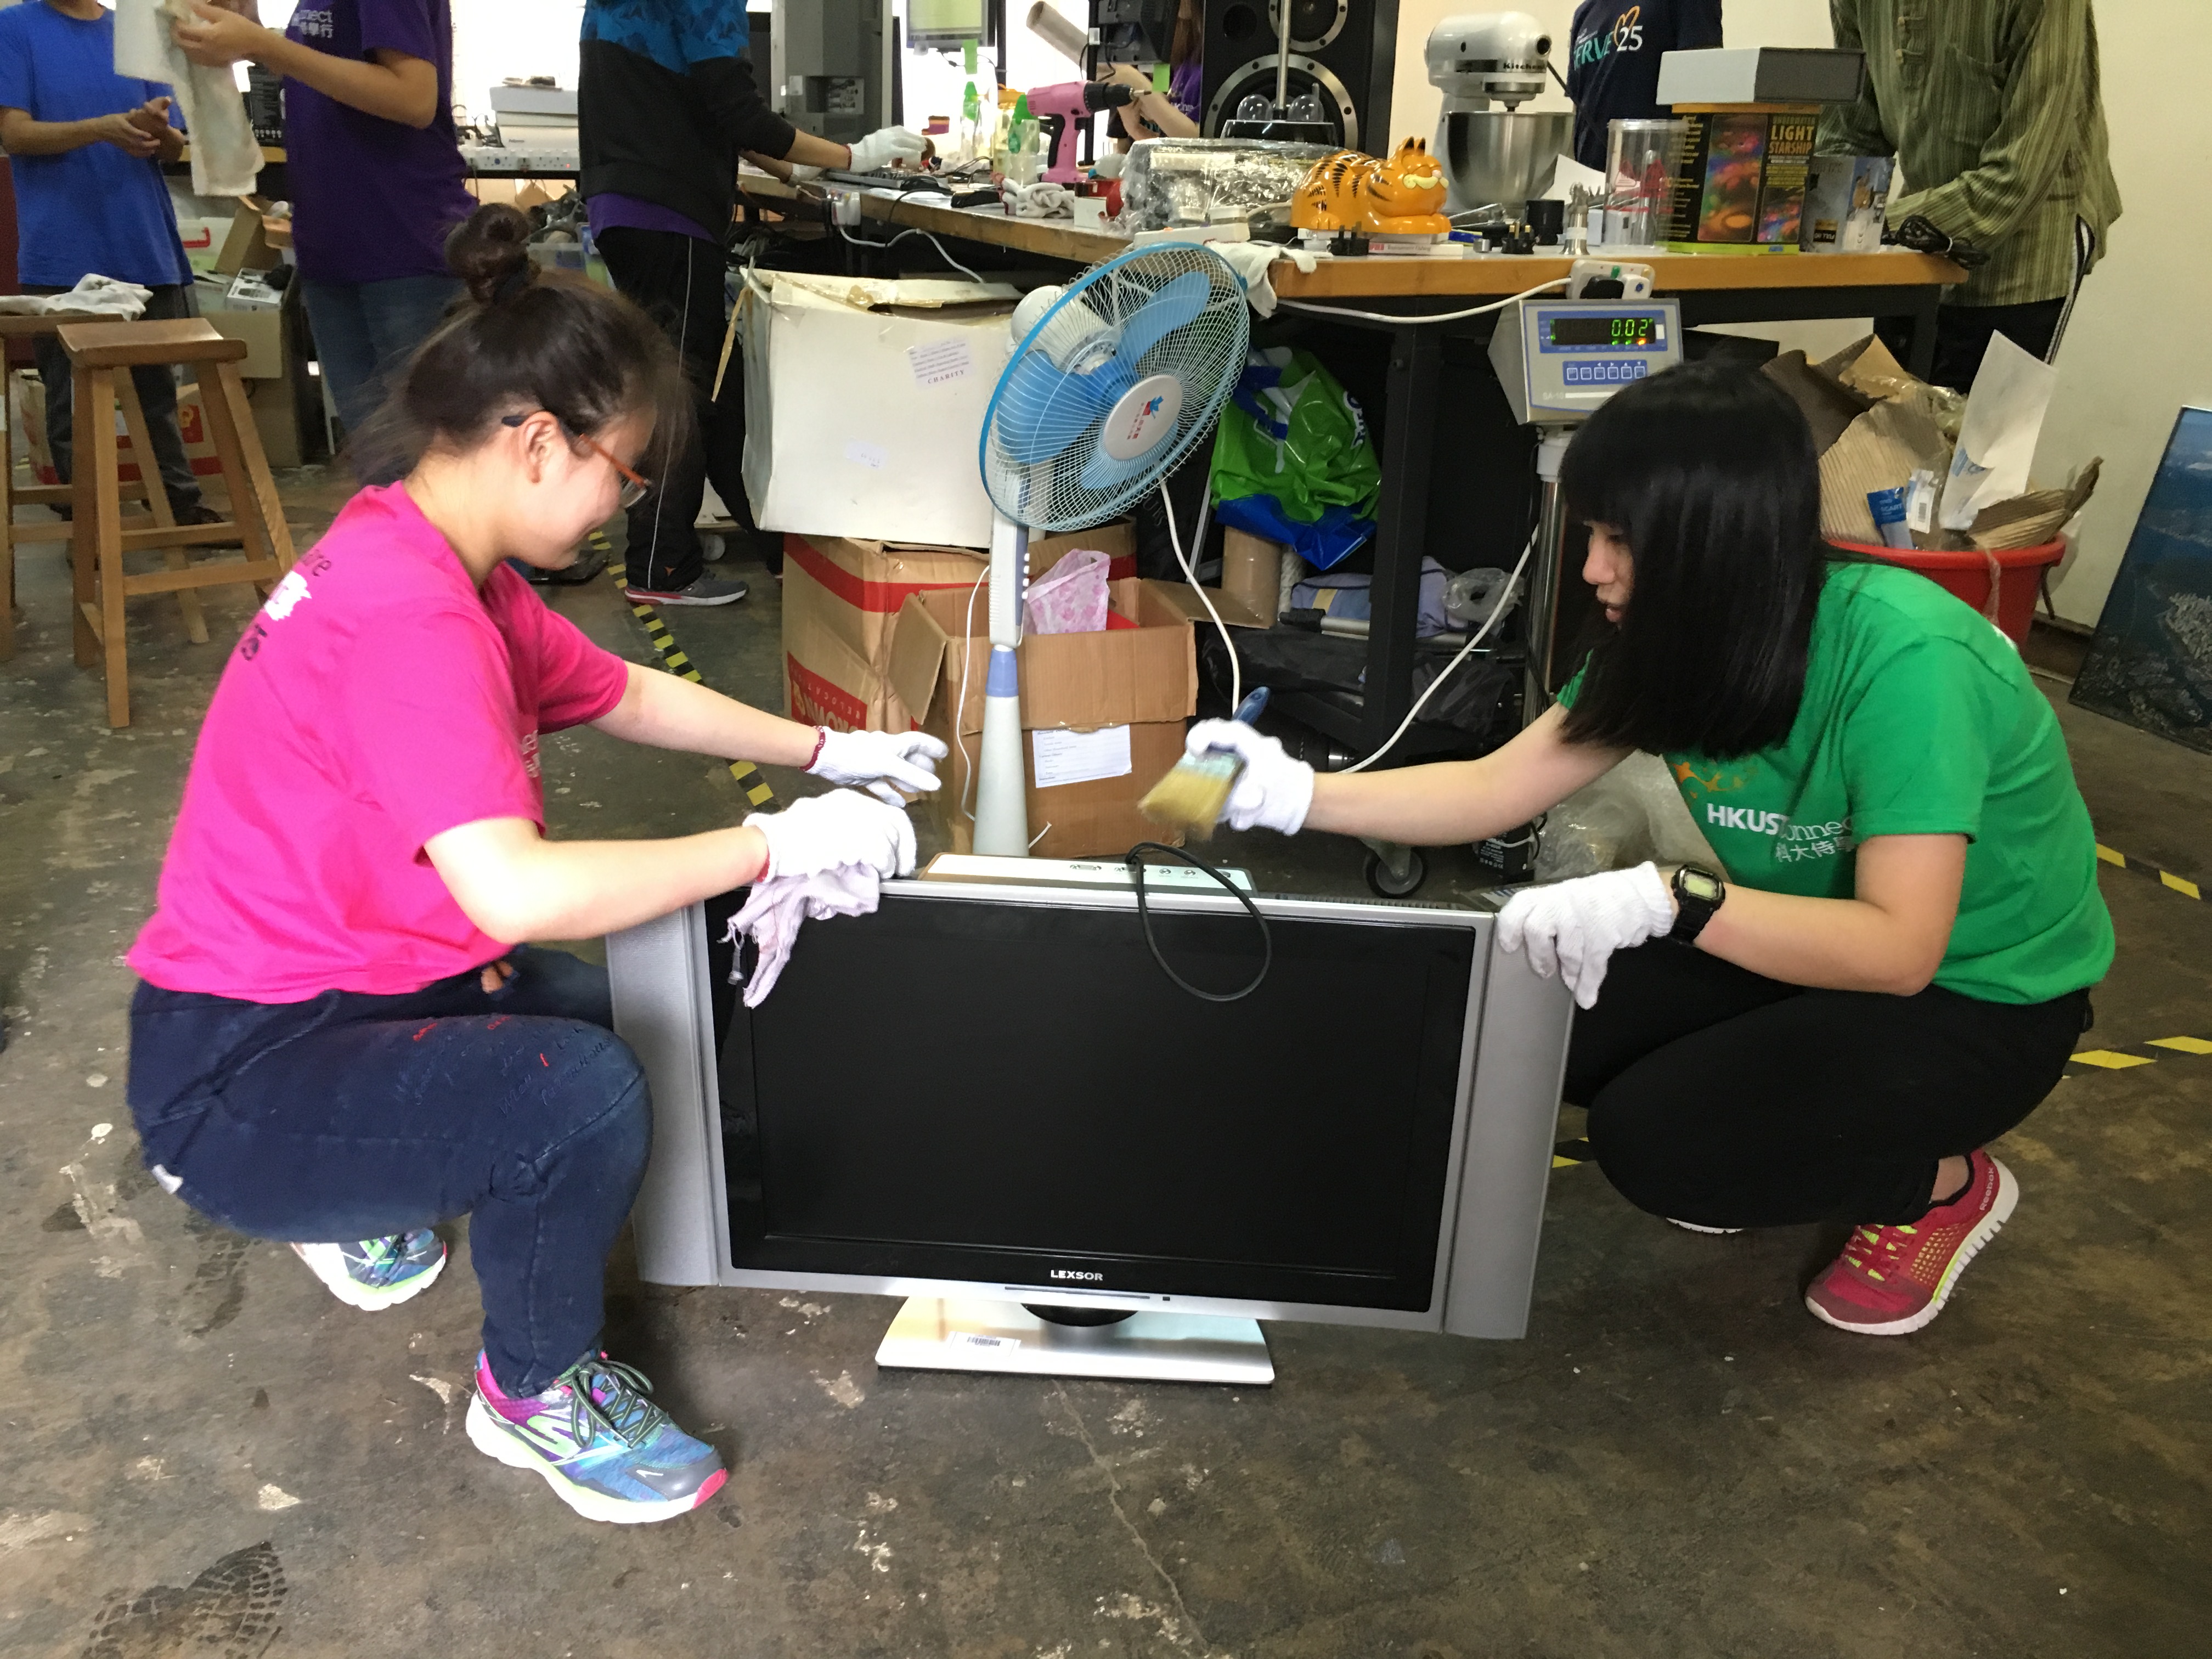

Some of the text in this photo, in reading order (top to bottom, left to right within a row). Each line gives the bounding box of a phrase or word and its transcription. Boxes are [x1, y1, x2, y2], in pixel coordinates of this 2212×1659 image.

[1617, 26, 1643, 52] 25
[1771, 125, 1814, 140] LIGHT
[1768, 141, 1812, 154] STARSHIP
[1611, 319, 1648, 336] 0.02
[927, 370, 964, 384] CHARITY
[1979, 1167, 1994, 1211] Reebok
[1051, 1269, 1103, 1281] LEXSOR
